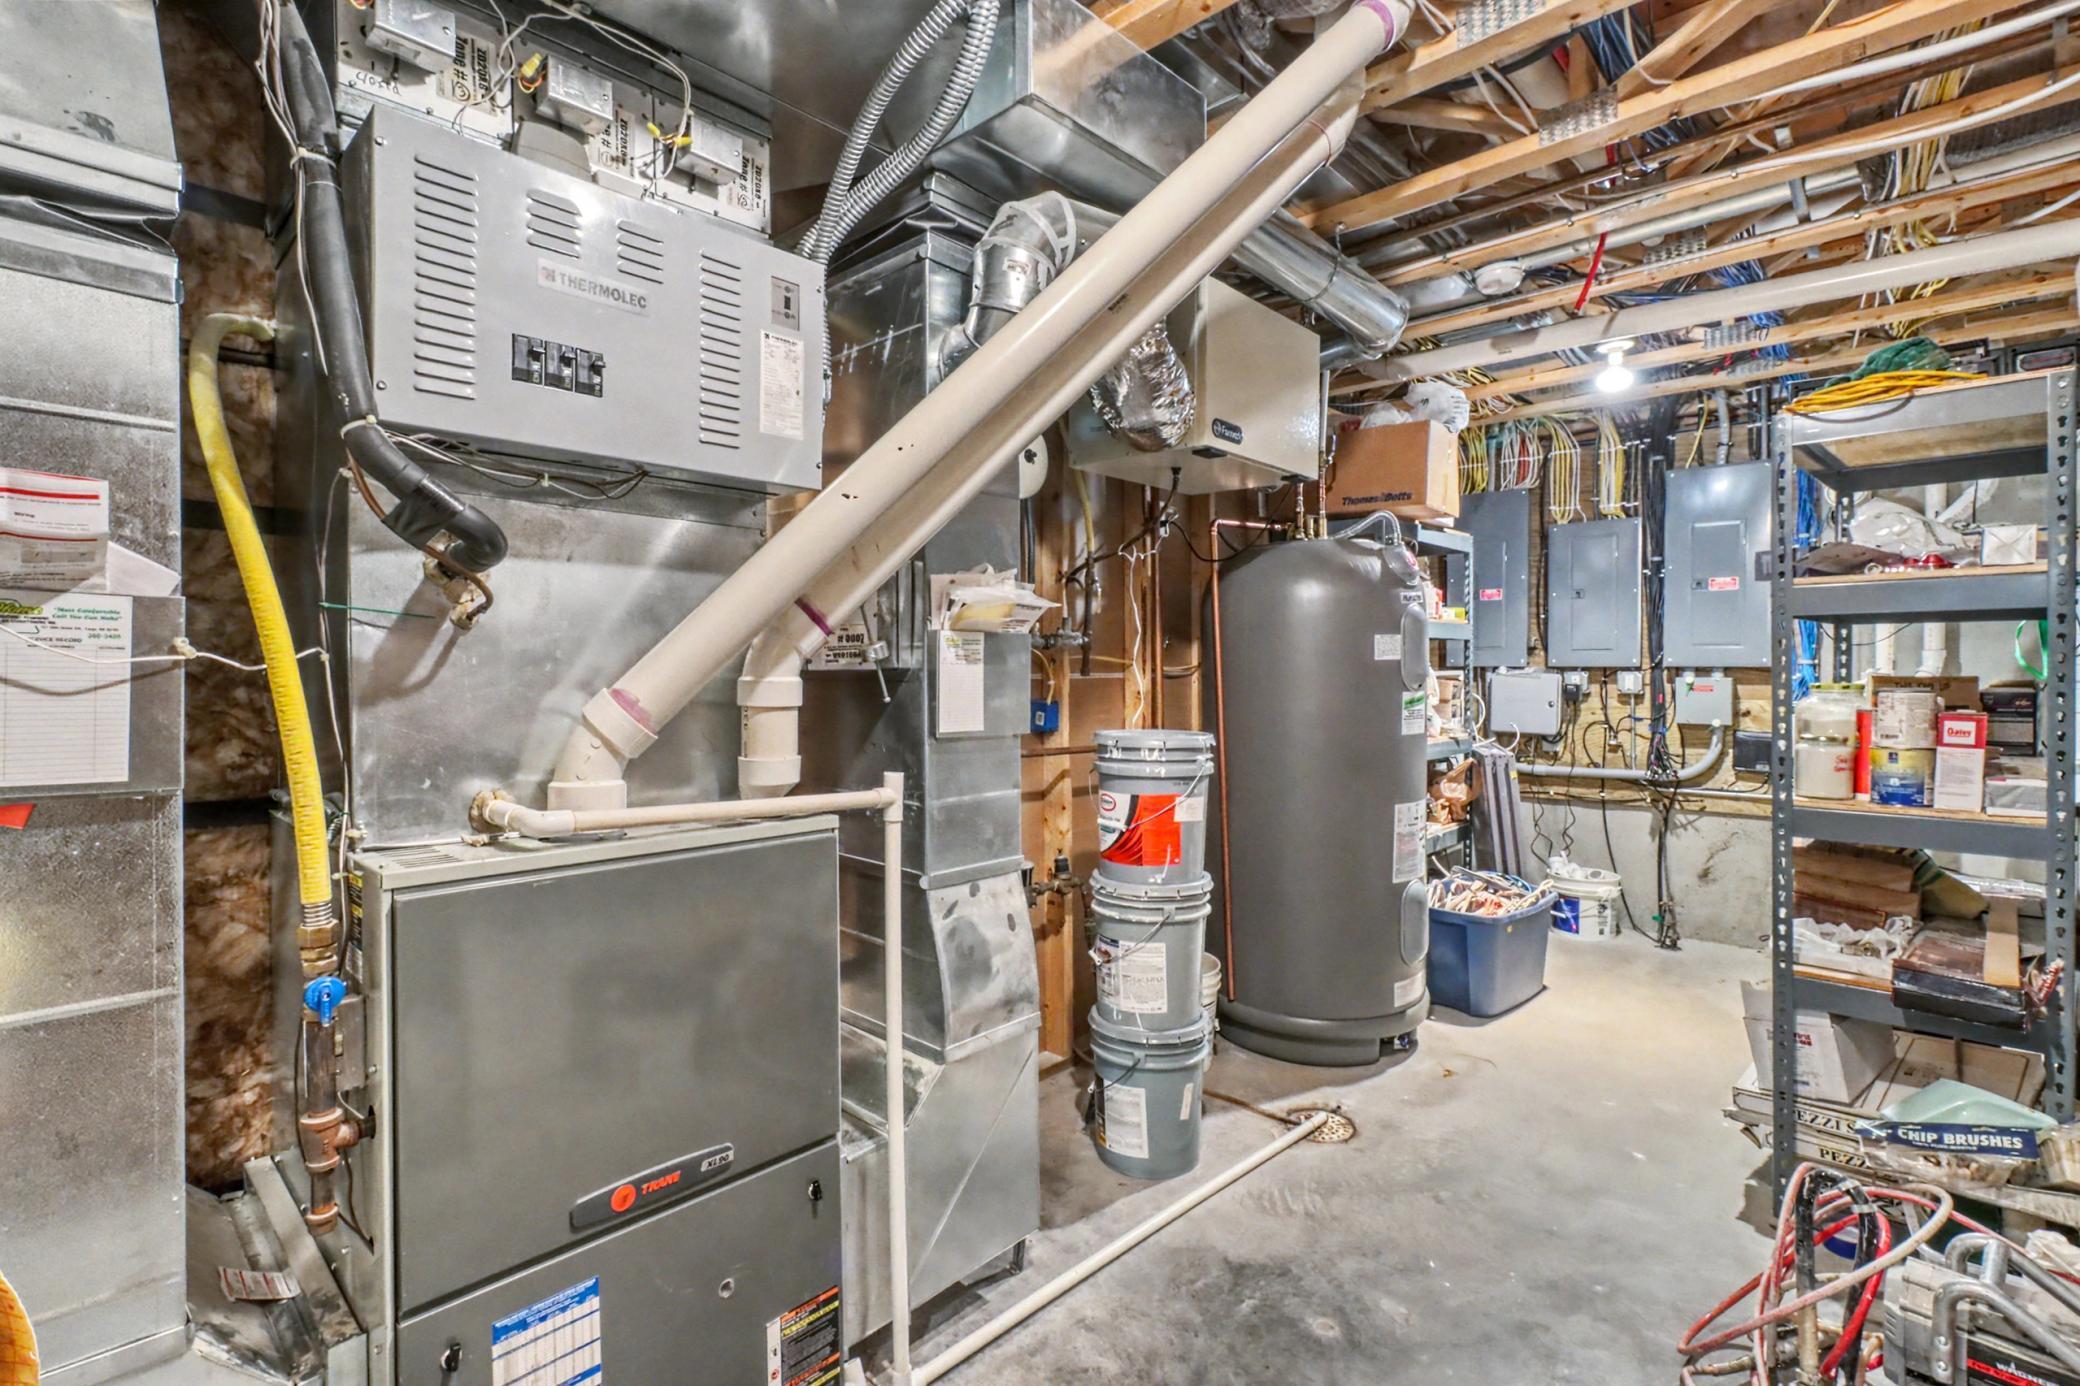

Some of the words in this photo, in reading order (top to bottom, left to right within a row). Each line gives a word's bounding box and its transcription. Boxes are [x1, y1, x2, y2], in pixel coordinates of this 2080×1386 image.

[559, 272, 647, 309] THERMOLEC
[1897, 1128, 1938, 1143] CHIP
[1943, 1133, 2024, 1149] BRUSHES
[641, 1170, 681, 1195] TRANE
[706, 1154, 730, 1169] XL90
